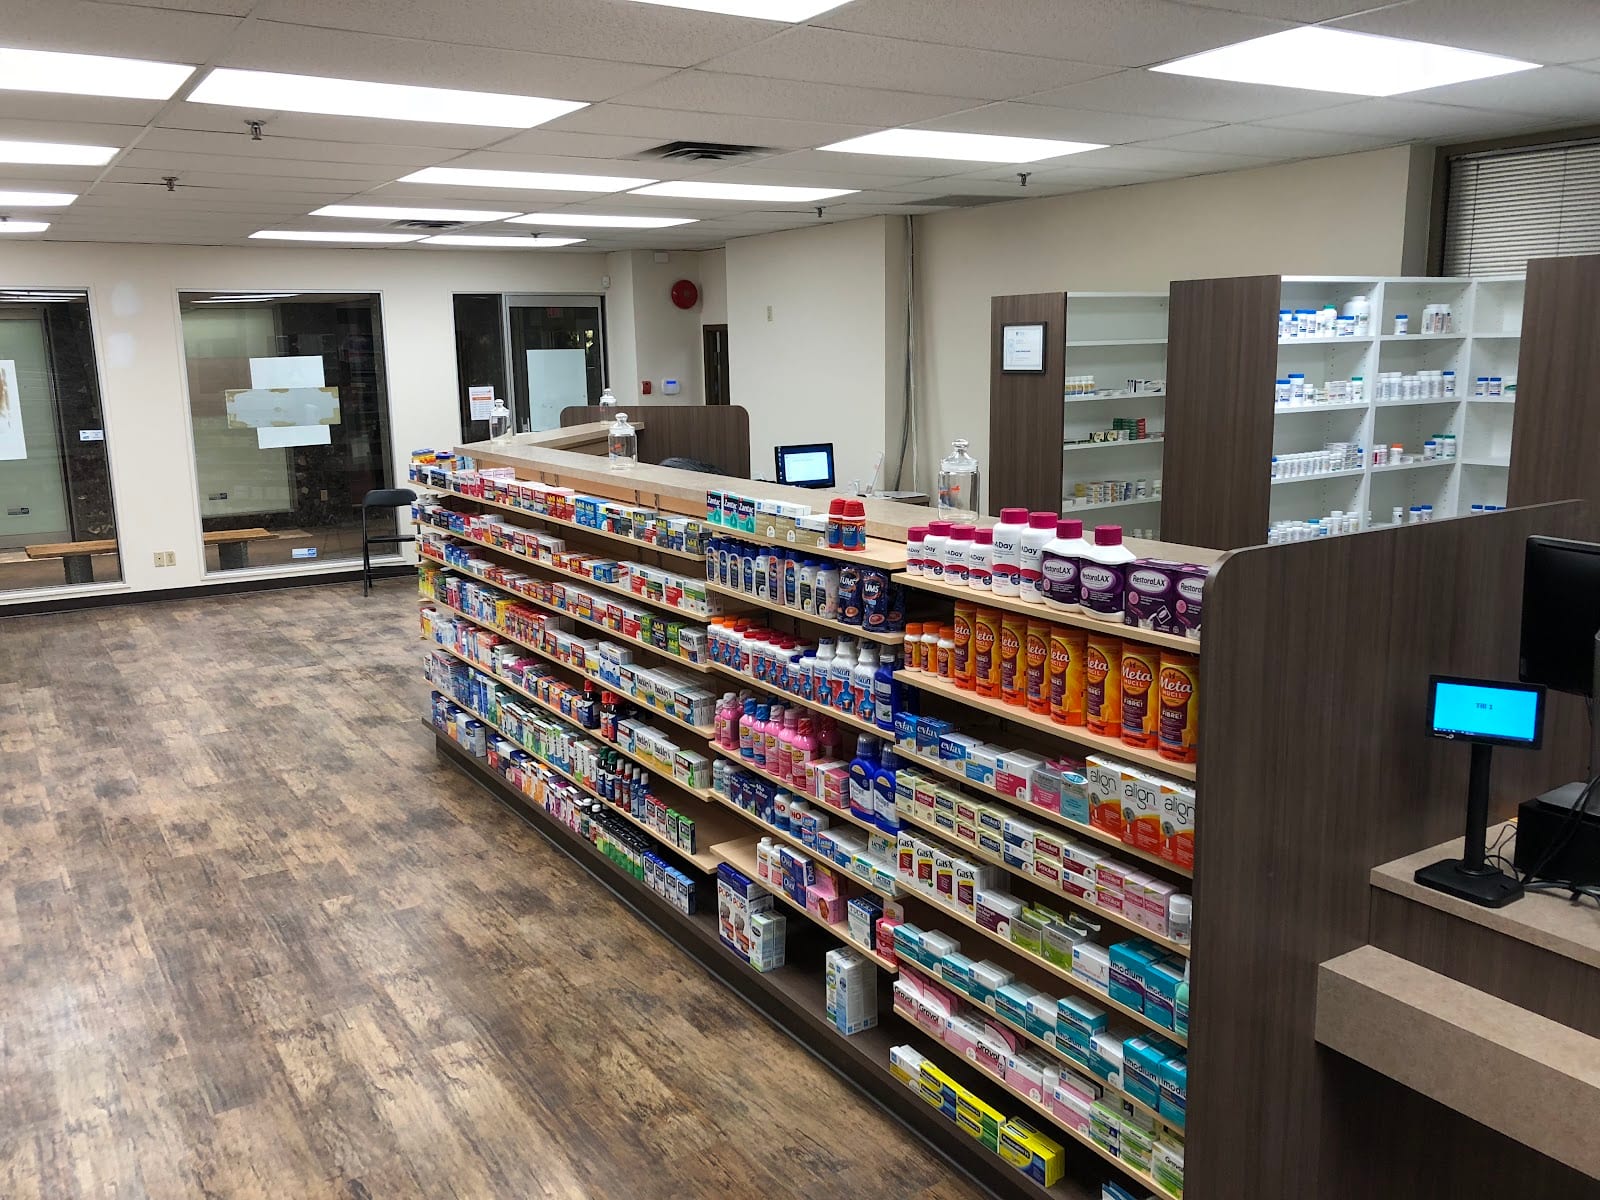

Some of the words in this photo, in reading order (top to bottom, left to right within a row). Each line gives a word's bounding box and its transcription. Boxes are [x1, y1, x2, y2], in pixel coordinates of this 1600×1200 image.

[738, 502, 754, 514] Zantac
[865, 583, 880, 593] UMS
[1132, 574, 1165, 587] RestoraLAX
[1161, 676, 1192, 693] Meta
[1090, 770, 1117, 795] align
[1124, 783, 1156, 810] align
[1111, 961, 1143, 983] Imodium
[977, 1040, 1000, 1061] Gravol
[1124, 1056, 1157, 1081] Imodium
[1160, 1077, 1187, 1097] Imodi
